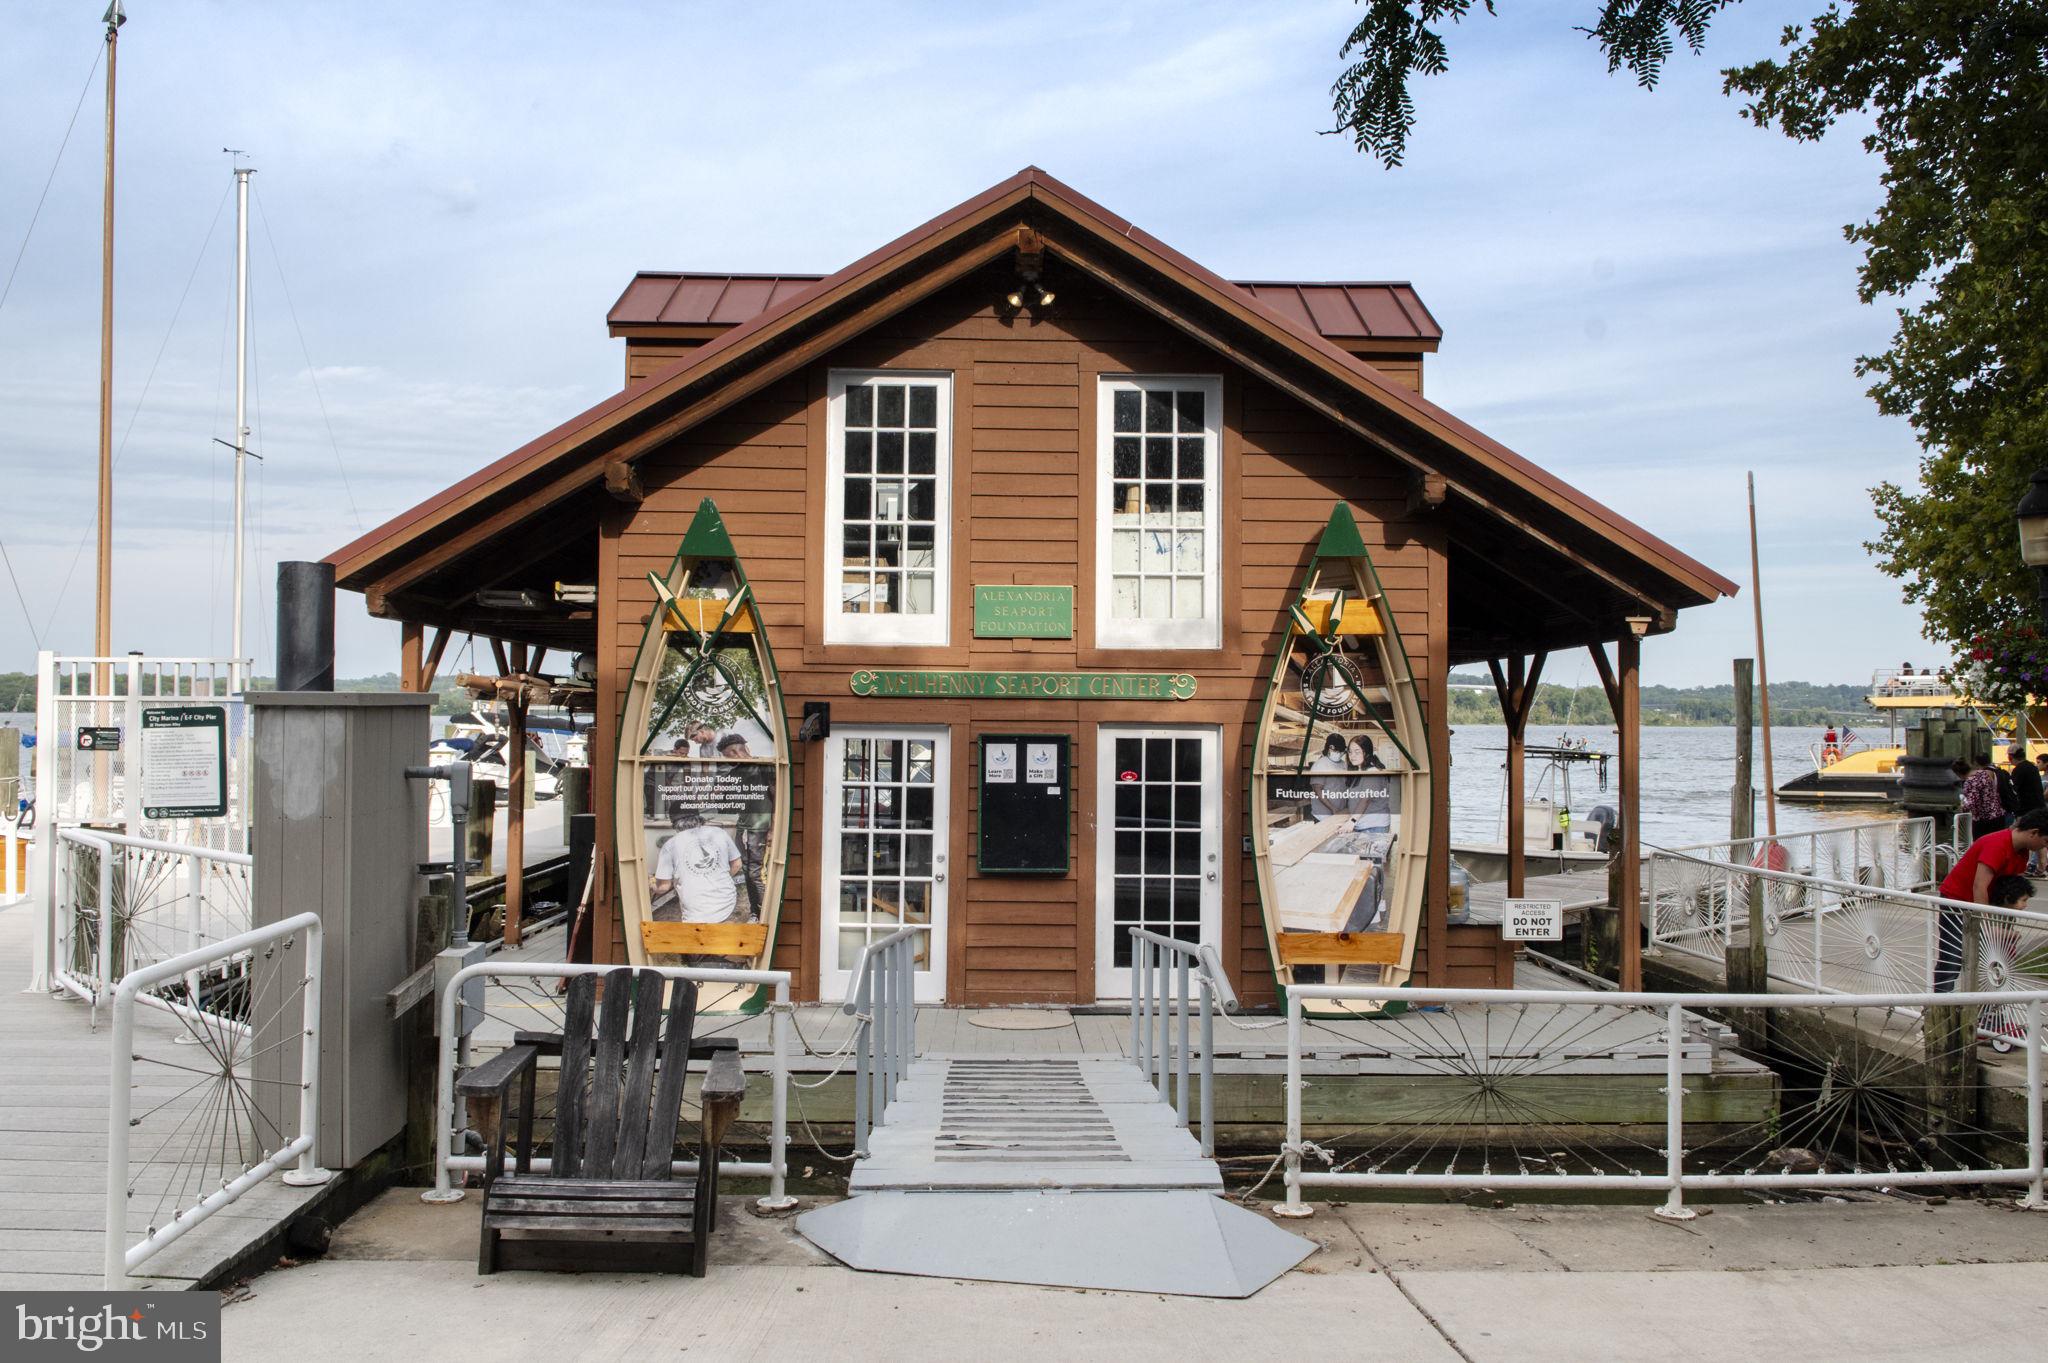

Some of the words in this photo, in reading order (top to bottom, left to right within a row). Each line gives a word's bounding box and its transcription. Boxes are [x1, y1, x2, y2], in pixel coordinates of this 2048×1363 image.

[982, 591, 1065, 601] ALEXANDRIA
[993, 606, 1055, 617] SEAPORT
[980, 621, 1066, 632] FOUNDATION
[995, 675, 1082, 695] SEAPORT
[1090, 676, 1161, 696] CENTER
[685, 775, 714, 783] Donate
[716, 775, 742, 784] Today:
[658, 784, 682, 793] Support
[694, 784, 712, 793] youth
[714, 784, 741, 793] choosing
[1275, 788, 1319, 799] Futures.
[1322, 788, 1390, 799] Handcrafted.
[680, 802, 746, 810] alexandriaseaport.org
[1513, 918, 1527, 926] DO
[1531, 918, 1552, 926] NOT
